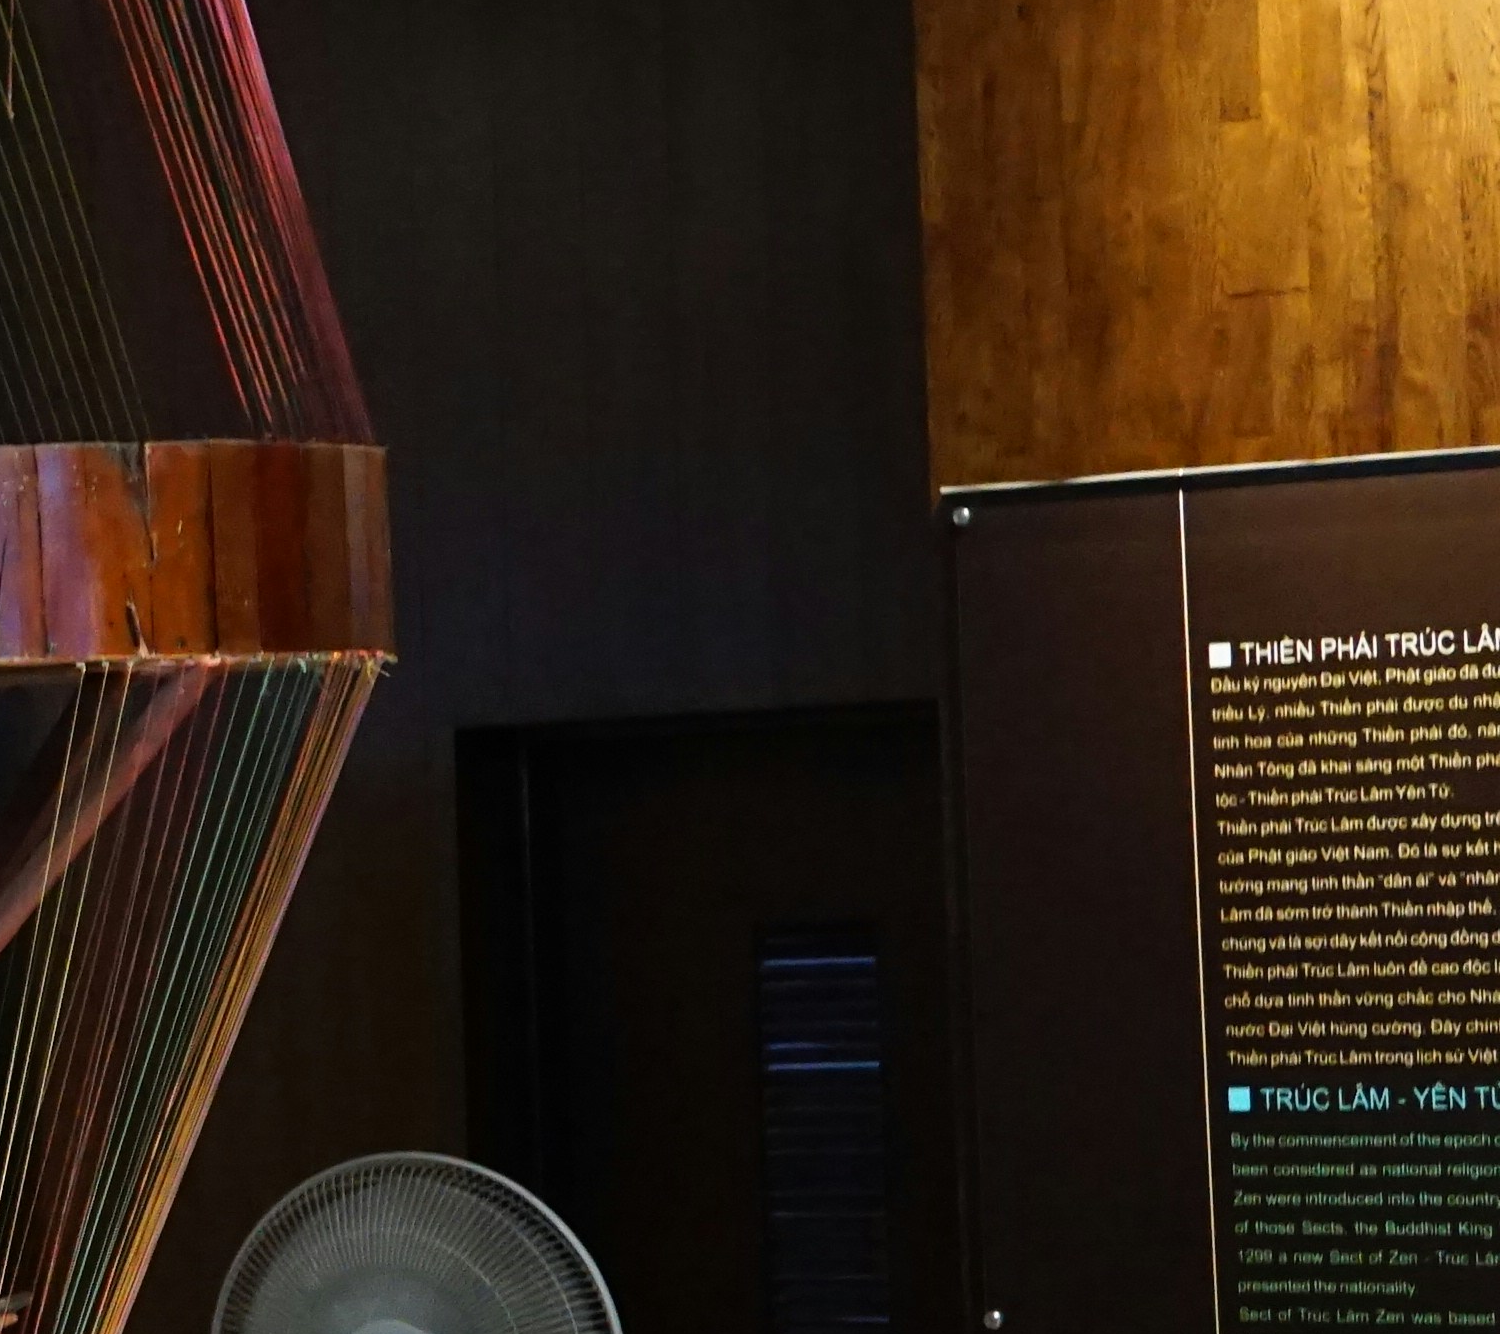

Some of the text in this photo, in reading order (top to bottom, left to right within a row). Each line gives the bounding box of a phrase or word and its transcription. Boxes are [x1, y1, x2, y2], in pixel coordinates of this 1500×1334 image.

[1240, 635, 1313, 666] THIỀN
[1321, 630, 1378, 661] PHÁI
[1385, 626, 1456, 657] TRÚC
[1257, 761, 1294, 779] Tông
[1321, 759, 1351, 774] khai
[1360, 786, 1393, 802] Lâm
[1331, 817, 1363, 832] Lâm
[1367, 815, 1407, 831] được
[1411, 813, 1437, 831] xây
[1441, 813, 1481, 830] dựng
[1338, 962, 1369, 977] Lâm
[1374, 961, 1405, 976] luôn
[1432, 962, 1459, 975] cao
[1438, 990, 1466, 1004] cho
[1340, 1050, 1372, 1065] Lâm
[1375, 1051, 1413, 1067] trong
[1260, 1083, 1329, 1111] TRÚC
[1339, 1083, 1389, 1111] LÂM
[1414, 1082, 1466, 1110] YÊN
[1231, 1132, 1490, 1150] By the commencement of the epoch
[1233, 1163, 1268, 1176] been
[1274, 1163, 1354, 1176] considered
[1360, 1165, 1377, 1176] as
[1383, 1163, 1441, 1177] national
[1234, 1190, 1261, 1206] Zen
[1266, 1194, 1301, 1206] were
[1306, 1192, 1383, 1205] introduced
[1388, 1192, 1415, 1205] into
[1419, 1192, 1442, 1206] the
[1235, 1220, 1249, 1233] of
[1255, 1221, 1294, 1235] those
[1355, 1222, 1378, 1235] the
[1385, 1220, 1450, 1235] Buddhist
[1459, 1222, 1492, 1239] King
[1279, 1252, 1287, 1264] a
[1294, 1253, 1323, 1264] new
[1330, 1250, 1363, 1264] Sect
[1369, 1250, 1383, 1264] of
[1389, 1250, 1417, 1265] Zen
[1238, 1280, 1310, 1293] presented
[1314, 1280, 1336, 1293] the
[1240, 1307, 1271, 1322] Sect
[1278, 1309, 1291, 1321] of
[1337, 1309, 1369, 1323] Lâm
[1376, 1309, 1404, 1324] Zen
[1411, 1313, 1441, 1324] was
[1449, 1311, 1495, 1325] based
